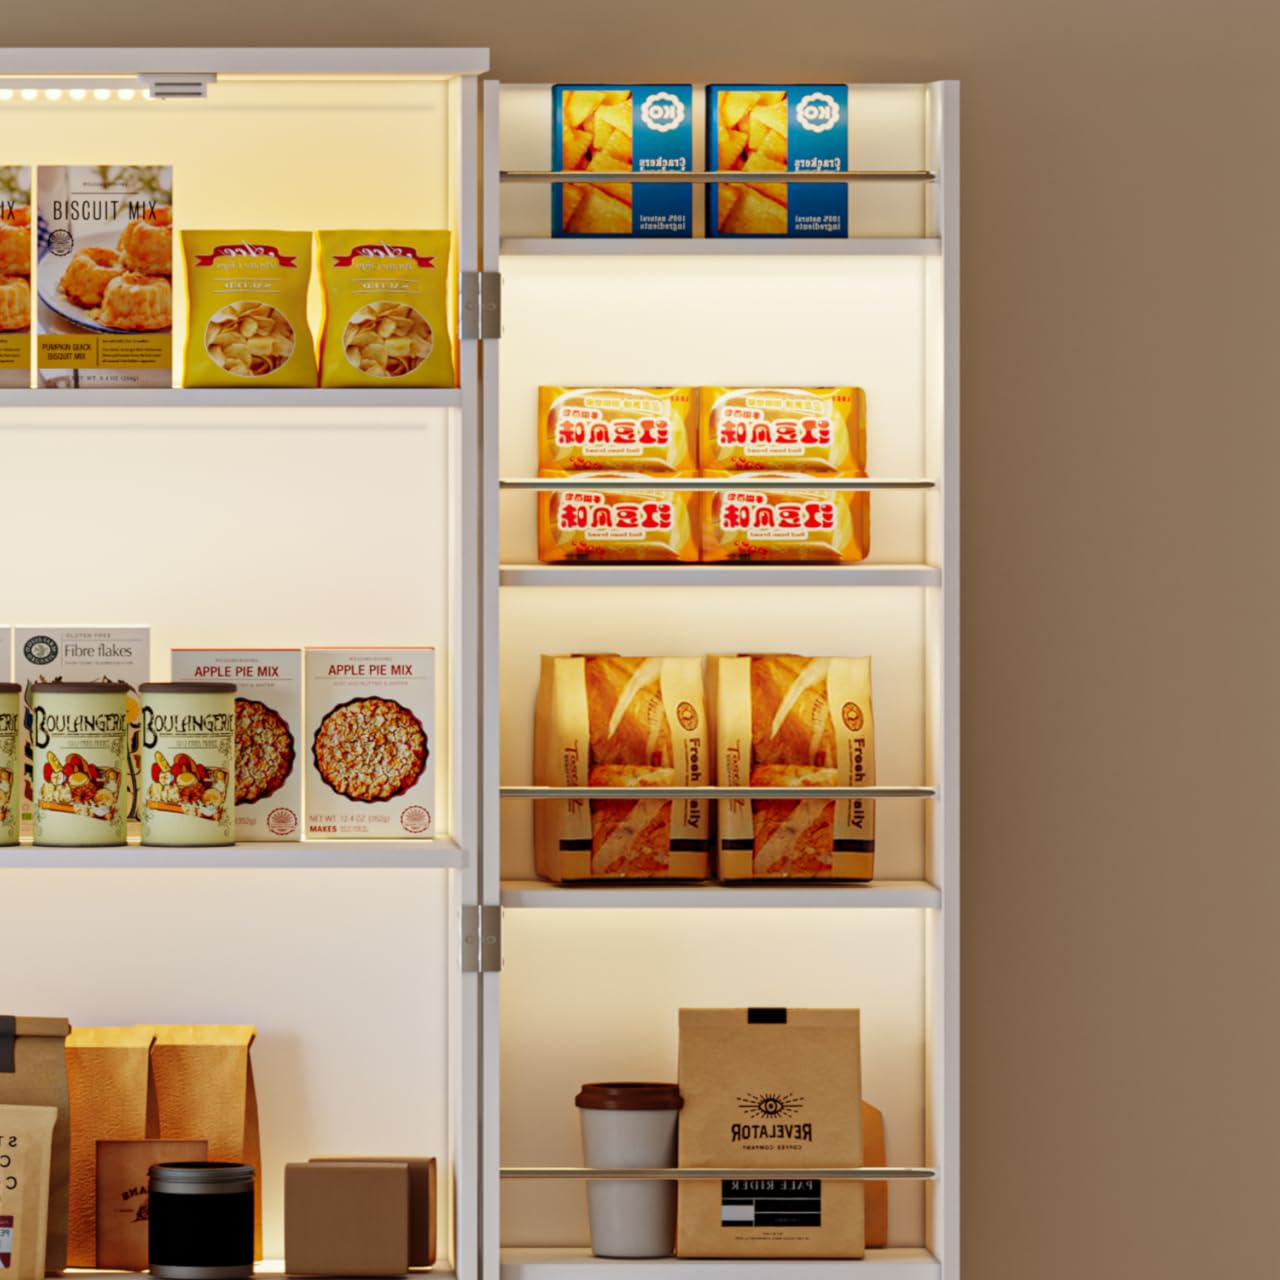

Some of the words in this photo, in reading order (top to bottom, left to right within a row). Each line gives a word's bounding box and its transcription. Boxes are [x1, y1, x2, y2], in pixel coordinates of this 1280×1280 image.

[53, 200, 120, 220] BISCUIT
[129, 200, 157, 220] MIX
[74, 352, 86, 360] MIX
[64, 643, 95, 657] Fibre
[98, 643, 132, 657] flakes
[194, 666, 231, 677] APPLE
[235, 666, 254, 677] PIE
[257, 666, 279, 677] MIX
[328, 664, 365, 676] APPLE
[369, 664, 387, 676] PIE
[391, 664, 412, 676] MIX
[34, 706, 128, 748] BOULANGERIE
[142, 706, 234, 748] BOULANGERIE
[687, 799, 700, 829] aily
[851, 799, 865, 829] aily
